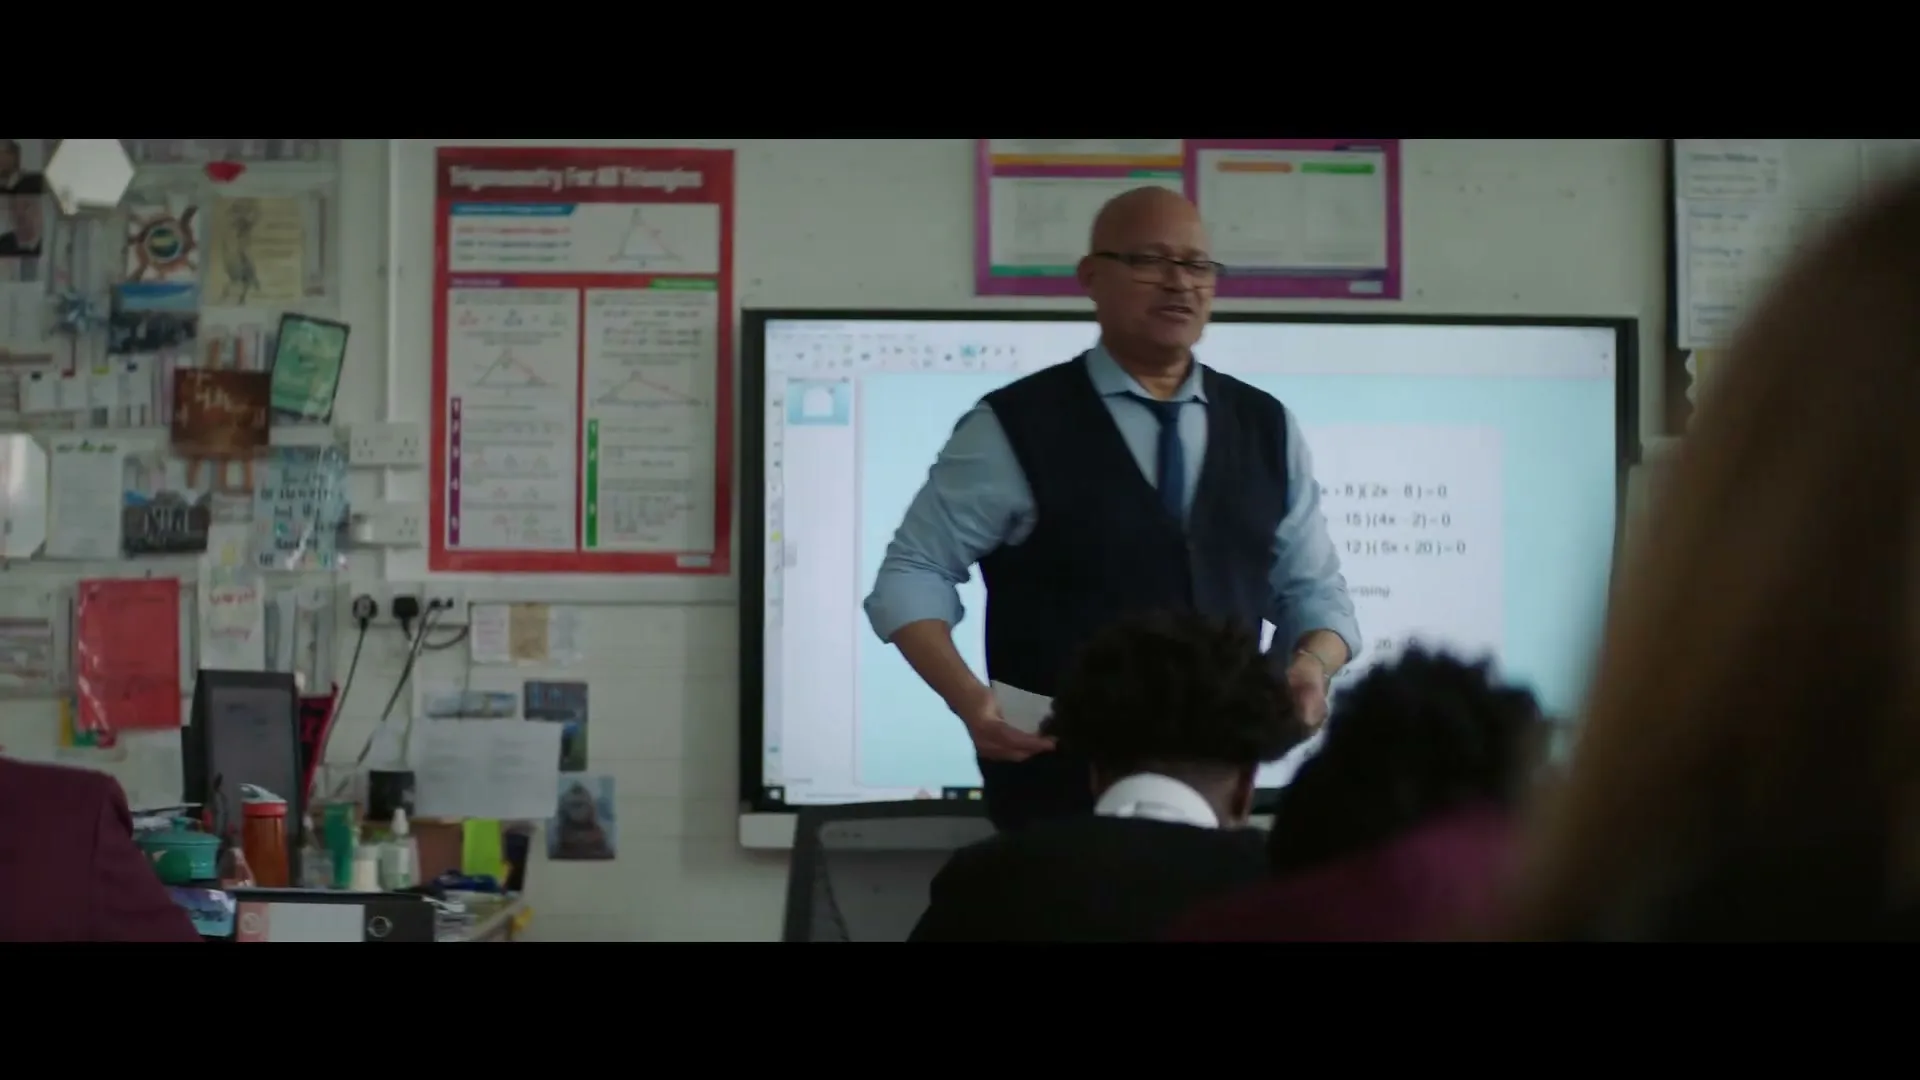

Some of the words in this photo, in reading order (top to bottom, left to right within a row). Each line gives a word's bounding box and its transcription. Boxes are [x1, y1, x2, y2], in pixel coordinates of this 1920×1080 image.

[450, 166, 561, 192] Trigonometry
[565, 166, 592, 187] For
[595, 165, 618, 187] All
[620, 165, 702, 192] Triangles
